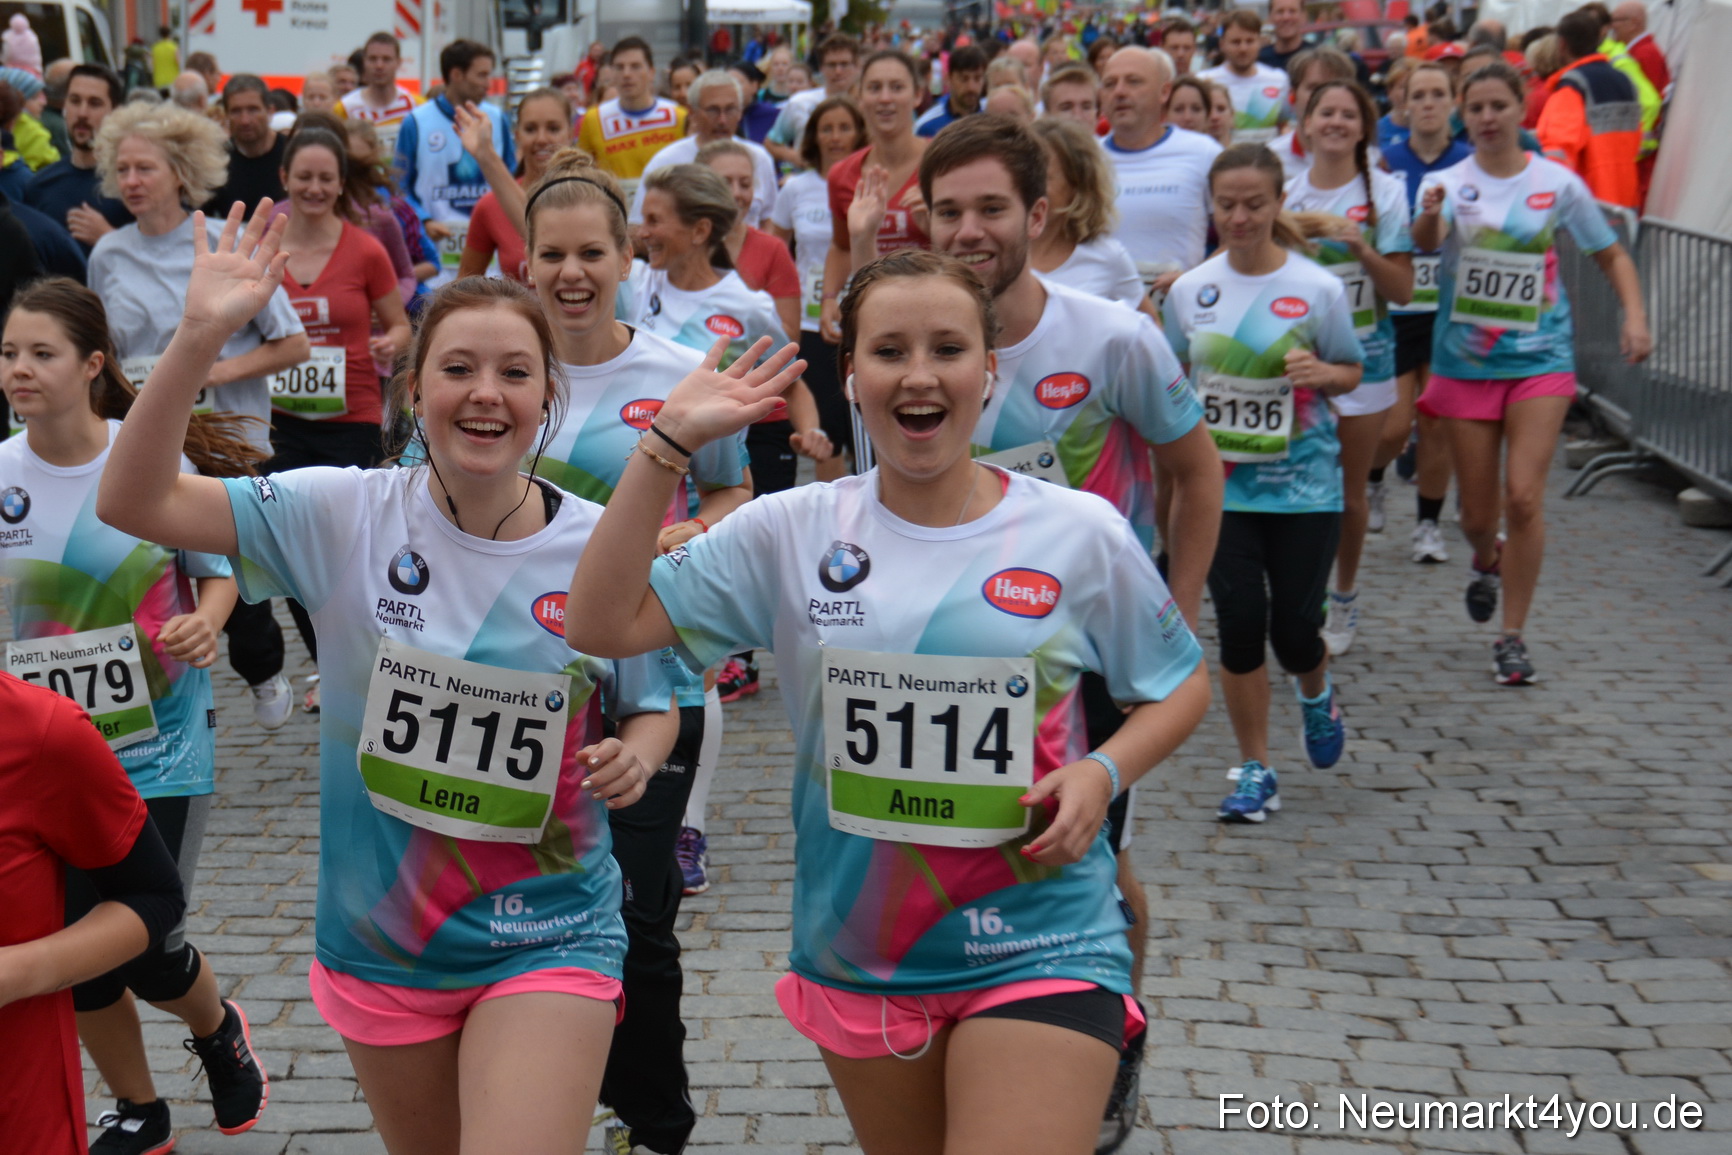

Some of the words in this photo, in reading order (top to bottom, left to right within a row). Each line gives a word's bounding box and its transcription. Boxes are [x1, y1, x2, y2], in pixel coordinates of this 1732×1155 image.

[292, 18, 328, 28] Kreuz
[1465, 268, 1536, 301] 5078
[273, 366, 337, 394] 5084
[1204, 395, 1283, 430] 5136
[0, 528, 33, 541] PARTL
[0, 539, 33, 549] Neumarkt
[994, 577, 1057, 606] Hervis
[376, 597, 426, 622] PARTL
[808, 598, 865, 615] PARTL
[375, 610, 424, 632] Neumarkt
[808, 613, 864, 627] Neumarkt
[11, 651, 48, 666] PARTL
[50, 642, 113, 662] Neumarkt
[379, 657, 440, 688] PARTL
[446, 676, 538, 708] Neumarkt
[828, 667, 892, 689] PARTL
[898, 673, 997, 694] Neumarkt
[382, 689, 547, 781] 5115
[846, 697, 1013, 774] 5114
[419, 779, 481, 814] Lena
[889, 788, 955, 819] Anna
[490, 893, 533, 916] 16.
[490, 910, 589, 934] Neumarkter
[962, 907, 1014, 936] 16.
[964, 931, 1079, 956] Neumarkter
